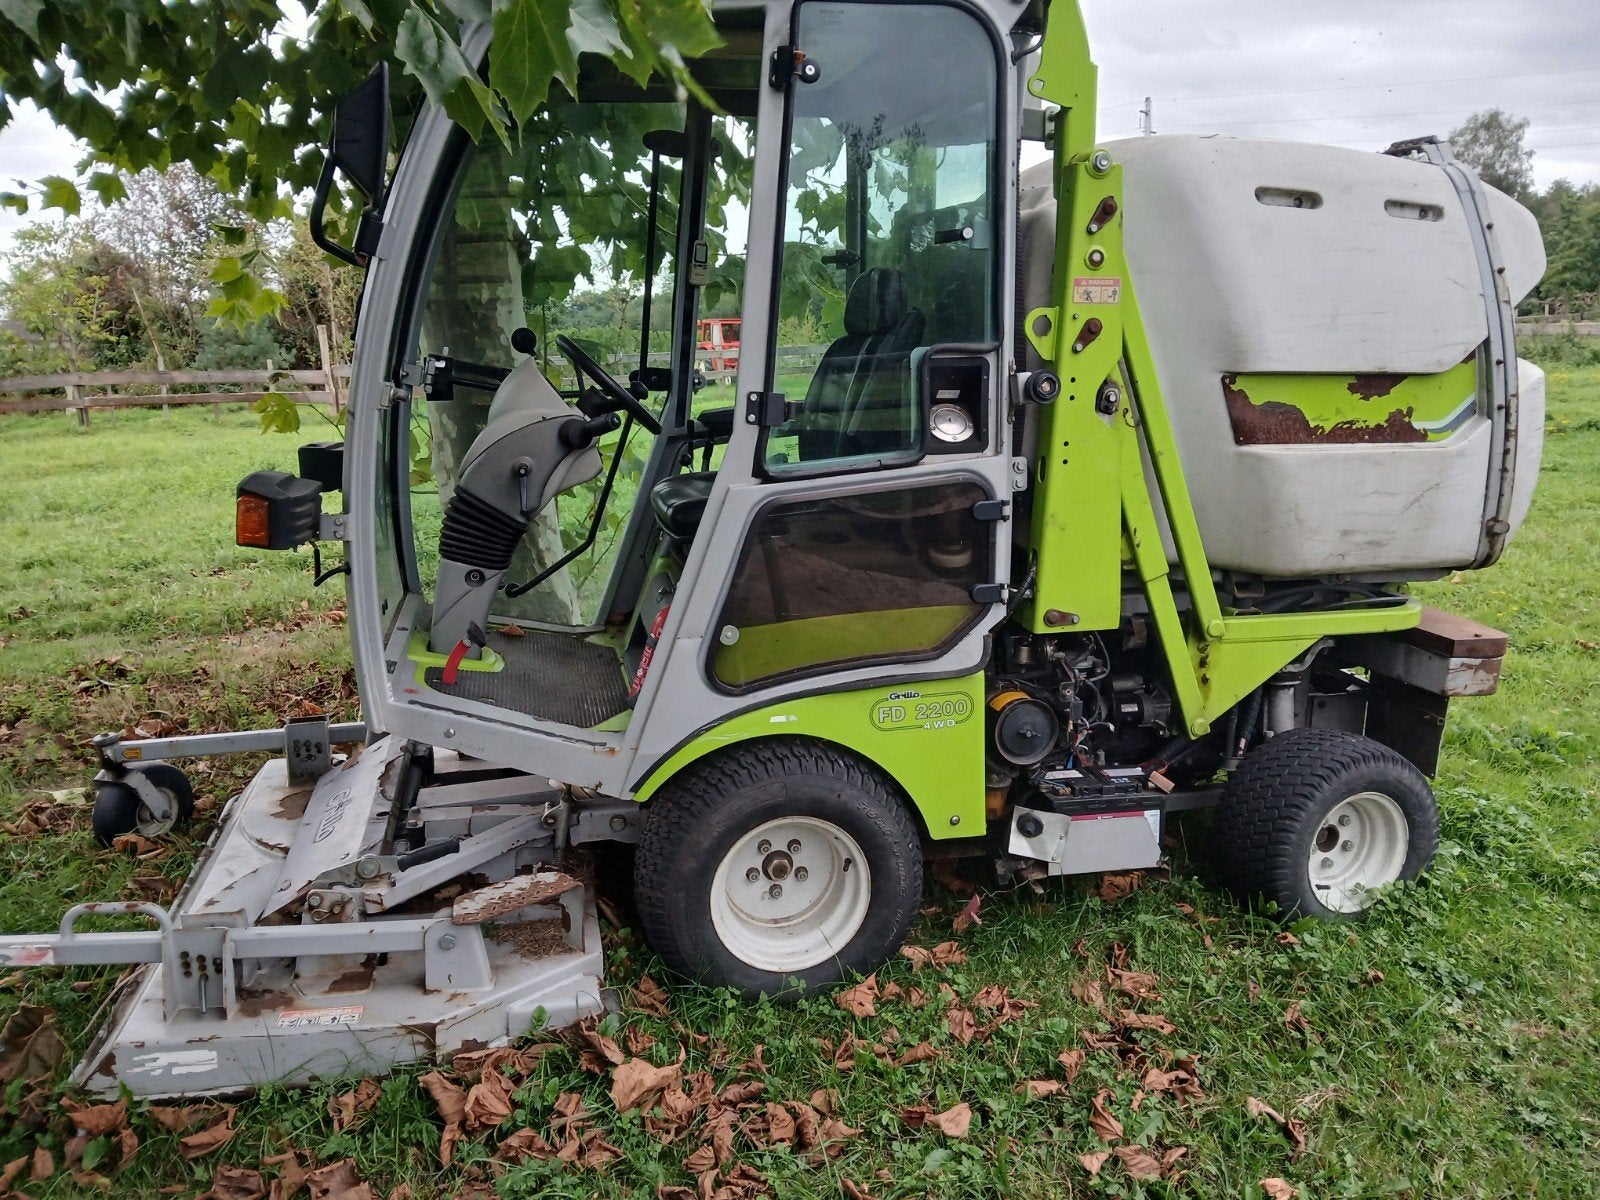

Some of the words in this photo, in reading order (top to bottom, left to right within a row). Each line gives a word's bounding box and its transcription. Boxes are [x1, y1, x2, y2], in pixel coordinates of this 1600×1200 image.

[889, 691, 920, 700] Grillo
[878, 706, 906, 723] FD
[915, 700, 968, 720] 2200
